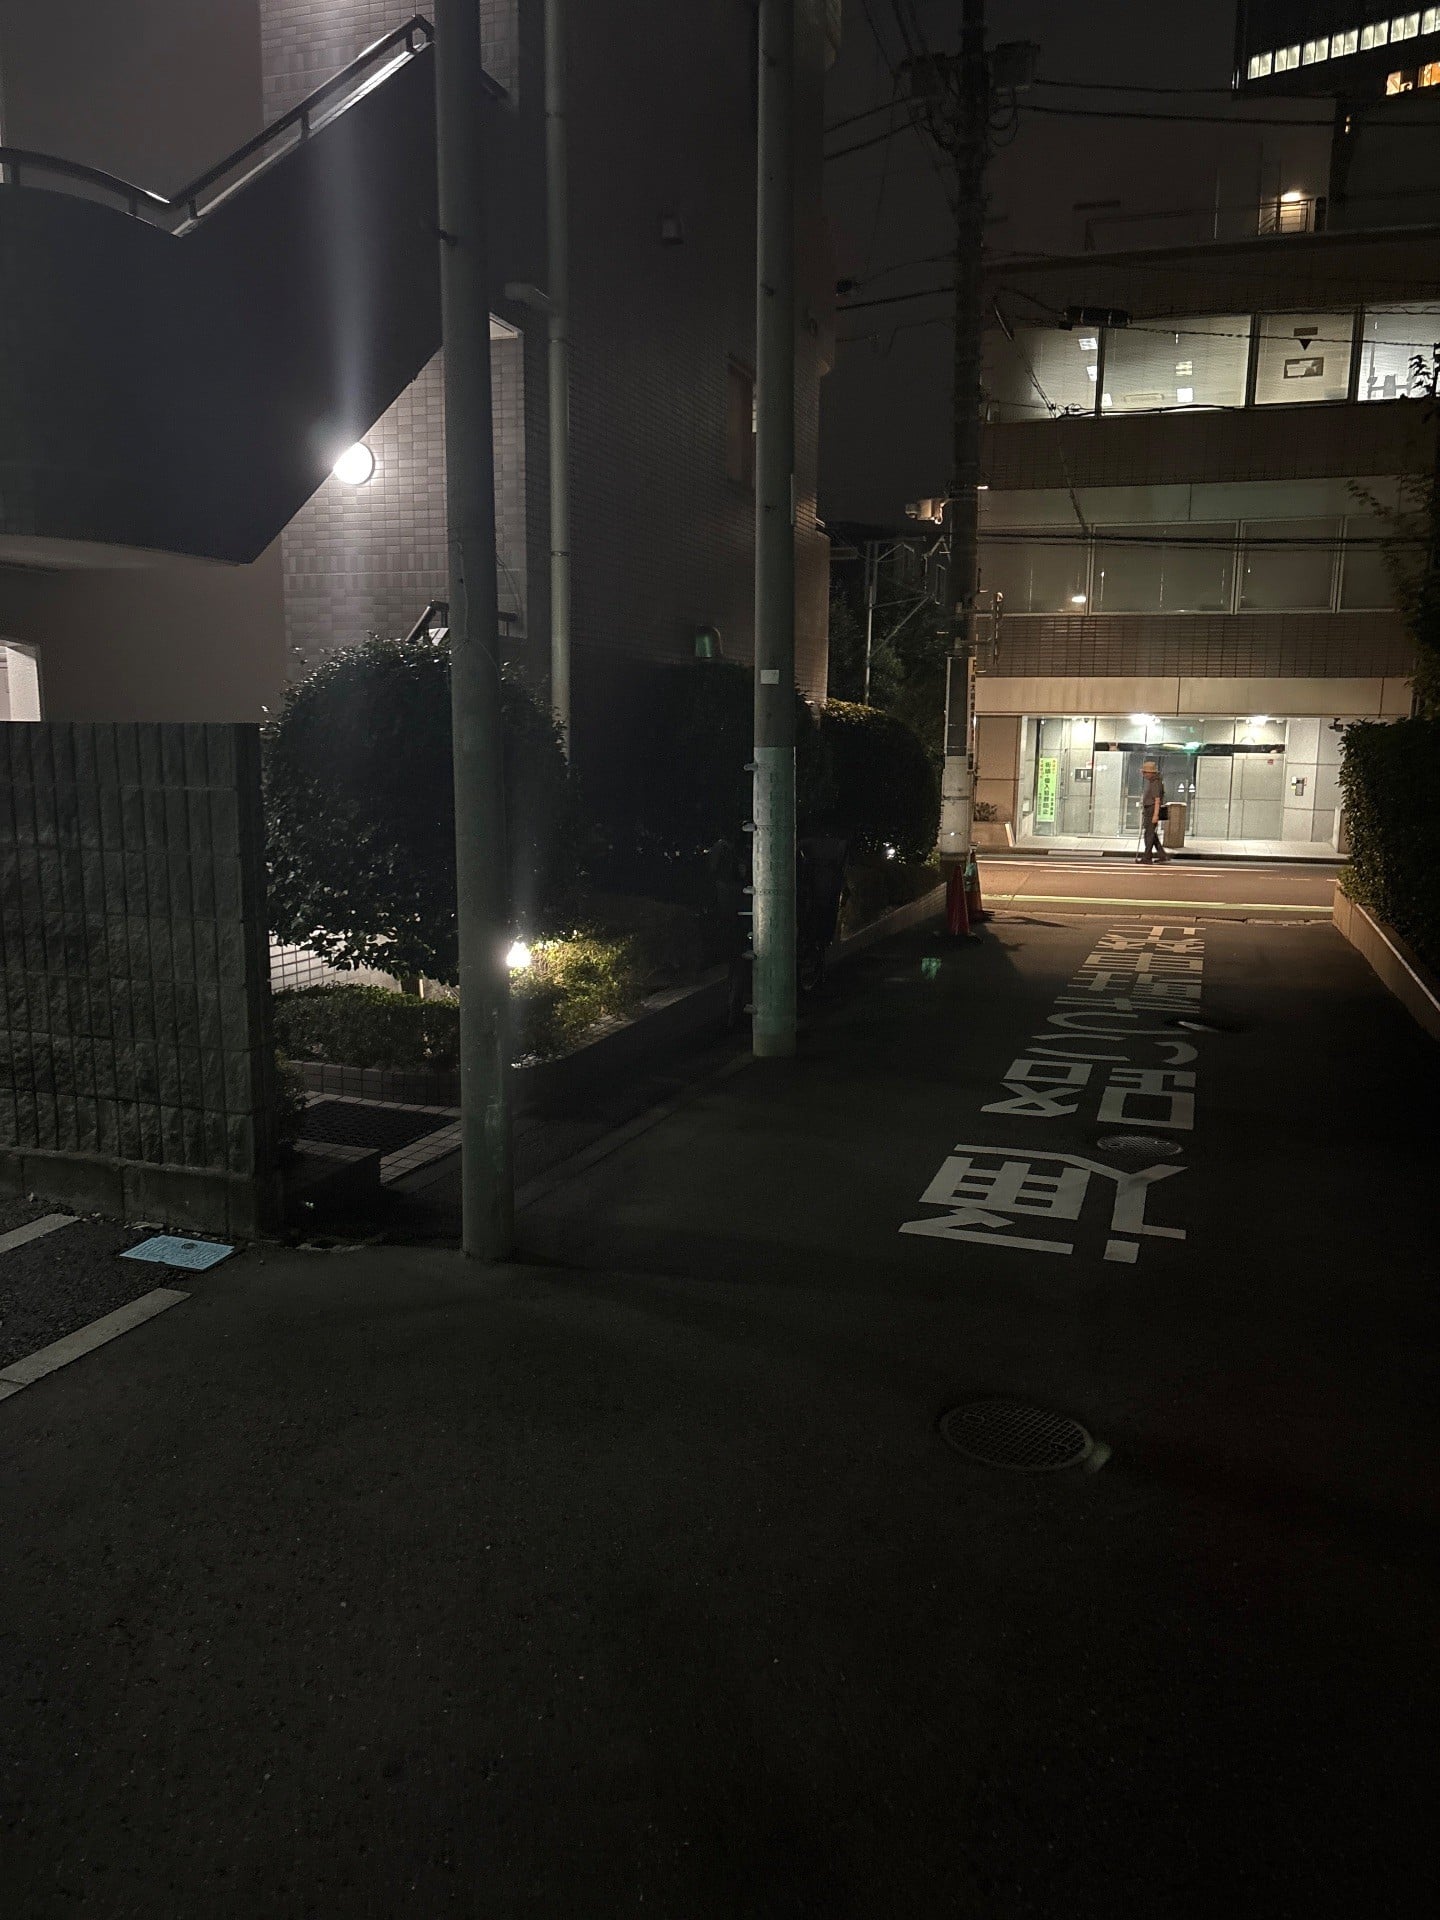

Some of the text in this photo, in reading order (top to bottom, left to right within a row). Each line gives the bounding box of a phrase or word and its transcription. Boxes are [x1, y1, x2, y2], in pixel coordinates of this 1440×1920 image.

[899, 924, 1206, 1264] 通路につき駐車禁止
